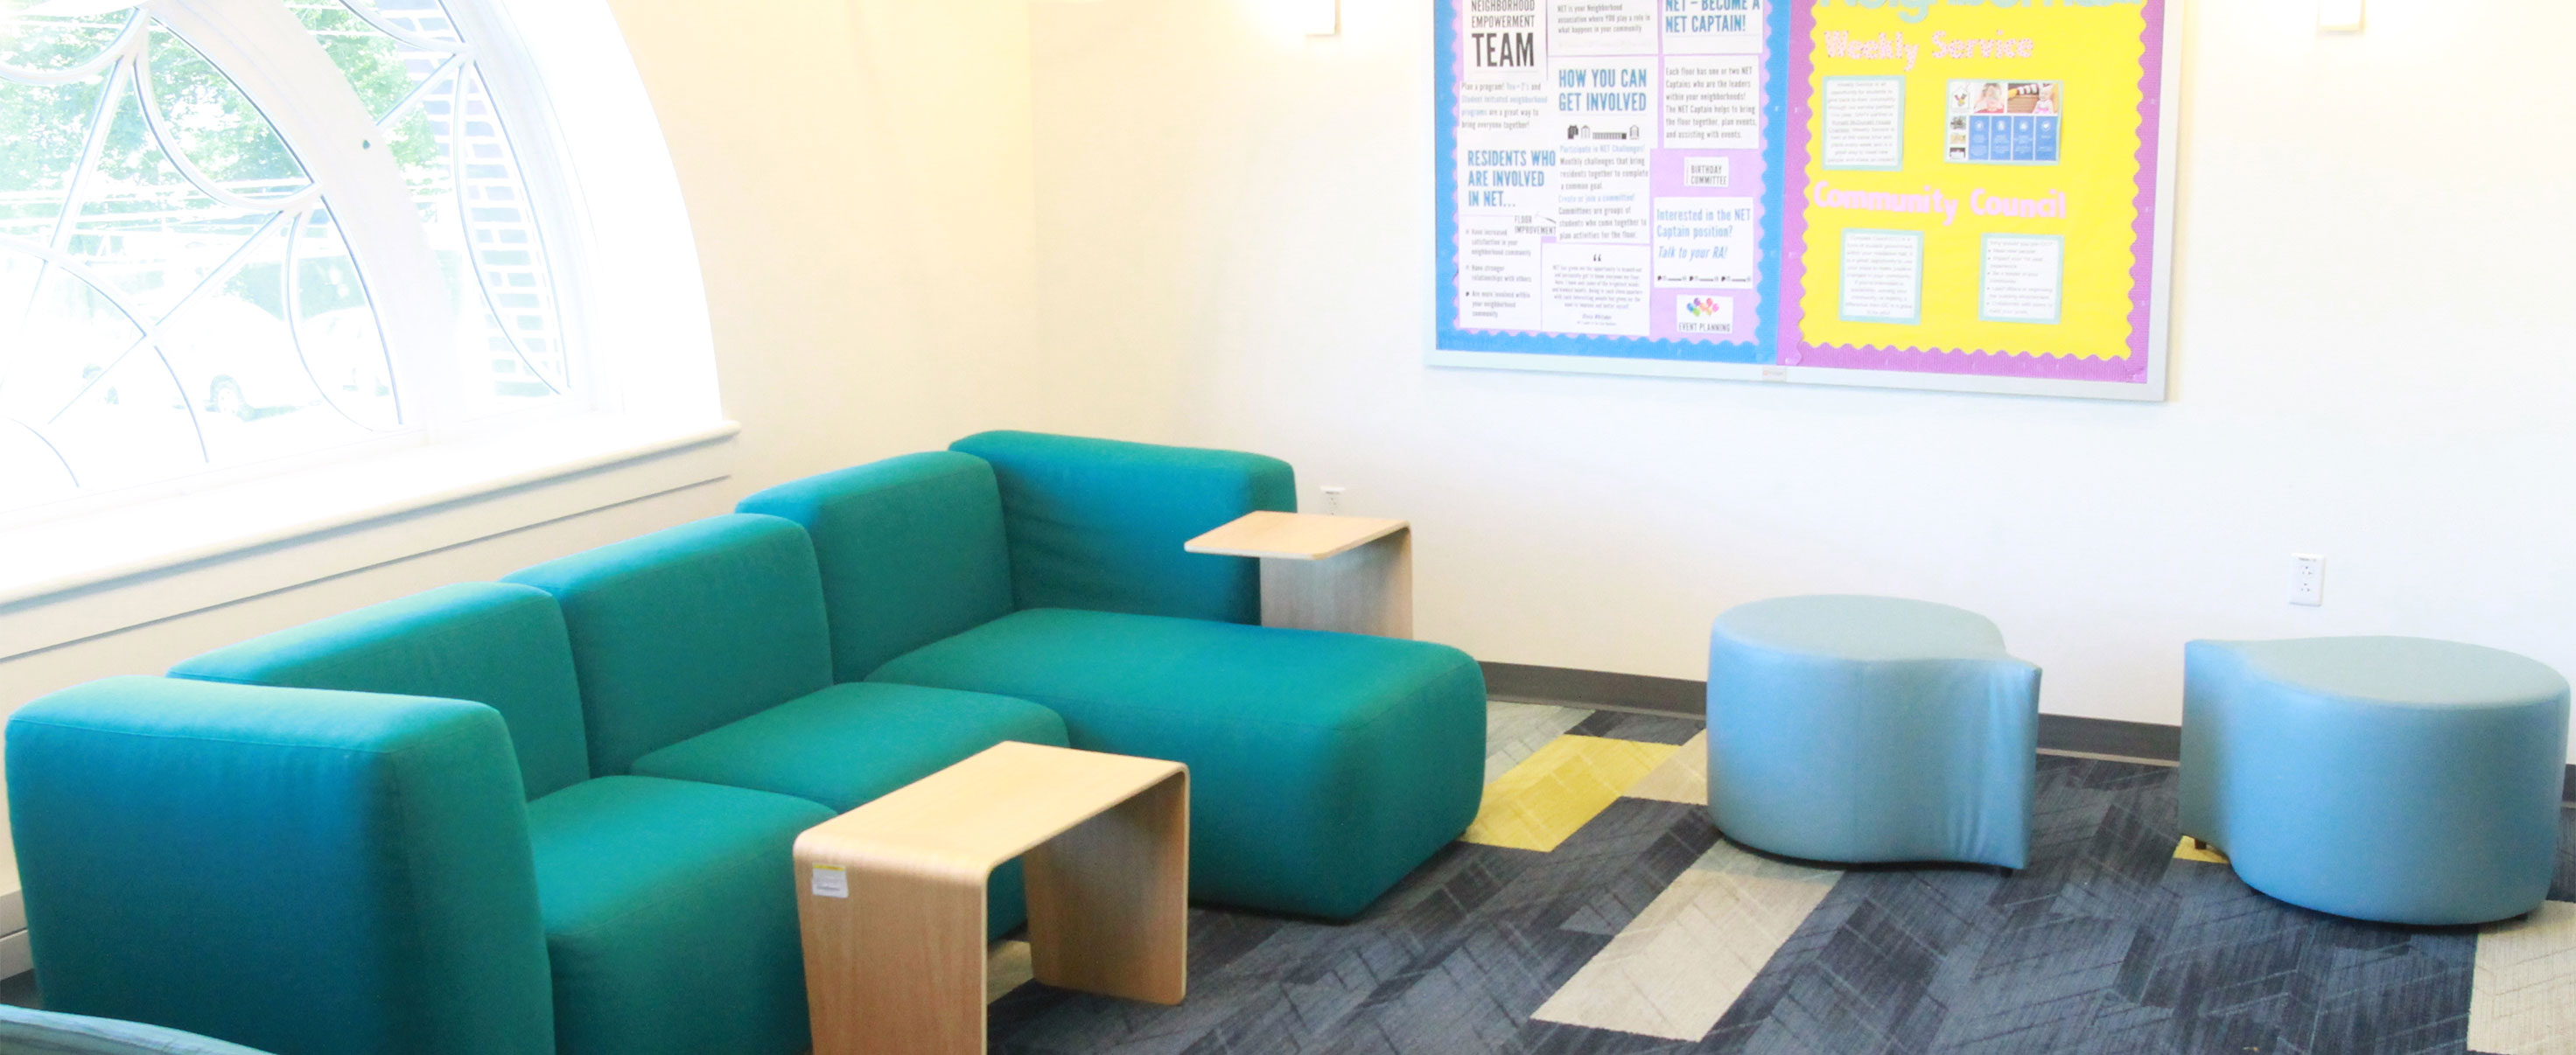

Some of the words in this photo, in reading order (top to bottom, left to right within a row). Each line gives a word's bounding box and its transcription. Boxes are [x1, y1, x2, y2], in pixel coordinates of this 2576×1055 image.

[1471, 0, 1535, 12] NEIGHBORHOOD
[1586, 3, 1622, 13] Neighborhood
[1701, 0, 1747, 10] BECOME
[1752, 0, 1760, 10] A
[1471, 15, 1535, 28] EMPOWERMENT
[1665, 16, 1687, 33] NET
[1691, 14, 1746, 32] CAPTAIN!
[1471, 32, 1535, 66] TEAM
[1824, 30, 1920, 72] Weekly
[1932, 29, 2034, 59] Service
[1681, 66, 1695, 75] floor
[1696, 66, 1707, 75] has
[1741, 66, 1753, 75] NET
[1558, 69, 1586, 88] HOW
[1591, 69, 1615, 88] YOU
[1620, 68, 1647, 88] CAN
[1666, 80, 1691, 89] Captains
[1692, 80, 1704, 88] who
[1717, 80, 1726, 88] the
[1728, 80, 1751, 88] leaders
[1558, 93, 1582, 111] GET
[1586, 93, 1646, 111] INVOLVED
[1666, 92, 1684, 101] within
[1686, 94, 1698, 102] your
[1677, 105, 1688, 114] NET
[1690, 105, 1712, 114] Captain
[1714, 105, 1730, 115] helps
[1740, 105, 1755, 115] bring
[1676, 117, 1691, 126] floor
[1721, 117, 1734, 127] plan
[1666, 130, 1676, 139] and
[1678, 130, 1704, 140] assisting
[1706, 130, 1719, 139] with
[1467, 150, 1527, 166] RESIDENTS
[1530, 150, 1556, 166] WHO
[1560, 157, 1582, 167] Monthly
[1584, 157, 1614, 167] challenges
[1629, 157, 1645, 166] bring
[1690, 164, 1722, 174] BIRTHDAY
[1468, 171, 1488, 186] ARE
[1493, 171, 1544, 187] INVOLVED
[1690, 176, 1727, 185] COMMITTEE
[1468, 190, 1480, 206] IN
[1483, 190, 1516, 206] NET...
[1813, 180, 1959, 226] Community
[1970, 188, 2066, 219] Council
[1558, 206, 1591, 215] Committees
[1604, 207, 1623, 216] groups
[1656, 208, 1703, 221] Interested
[1705, 209, 1713, 221] in
[1717, 209, 1731, 221] the
[1734, 208, 1751, 221] NET
[1515, 215, 1532, 224] FLOOR
[1515, 226, 1557, 235] IMPROVEMENT
[1656, 225, 1690, 241] Captain
[1693, 225, 1733, 240] position?
[1658, 246, 1676, 259] Talk
[1678, 247, 1688, 259] to
[1689, 248, 1710, 262] your
[1712, 246, 1728, 259] RA!
[1678, 323, 1698, 332] EVENT
[1699, 323, 1731, 332] PLANNING
